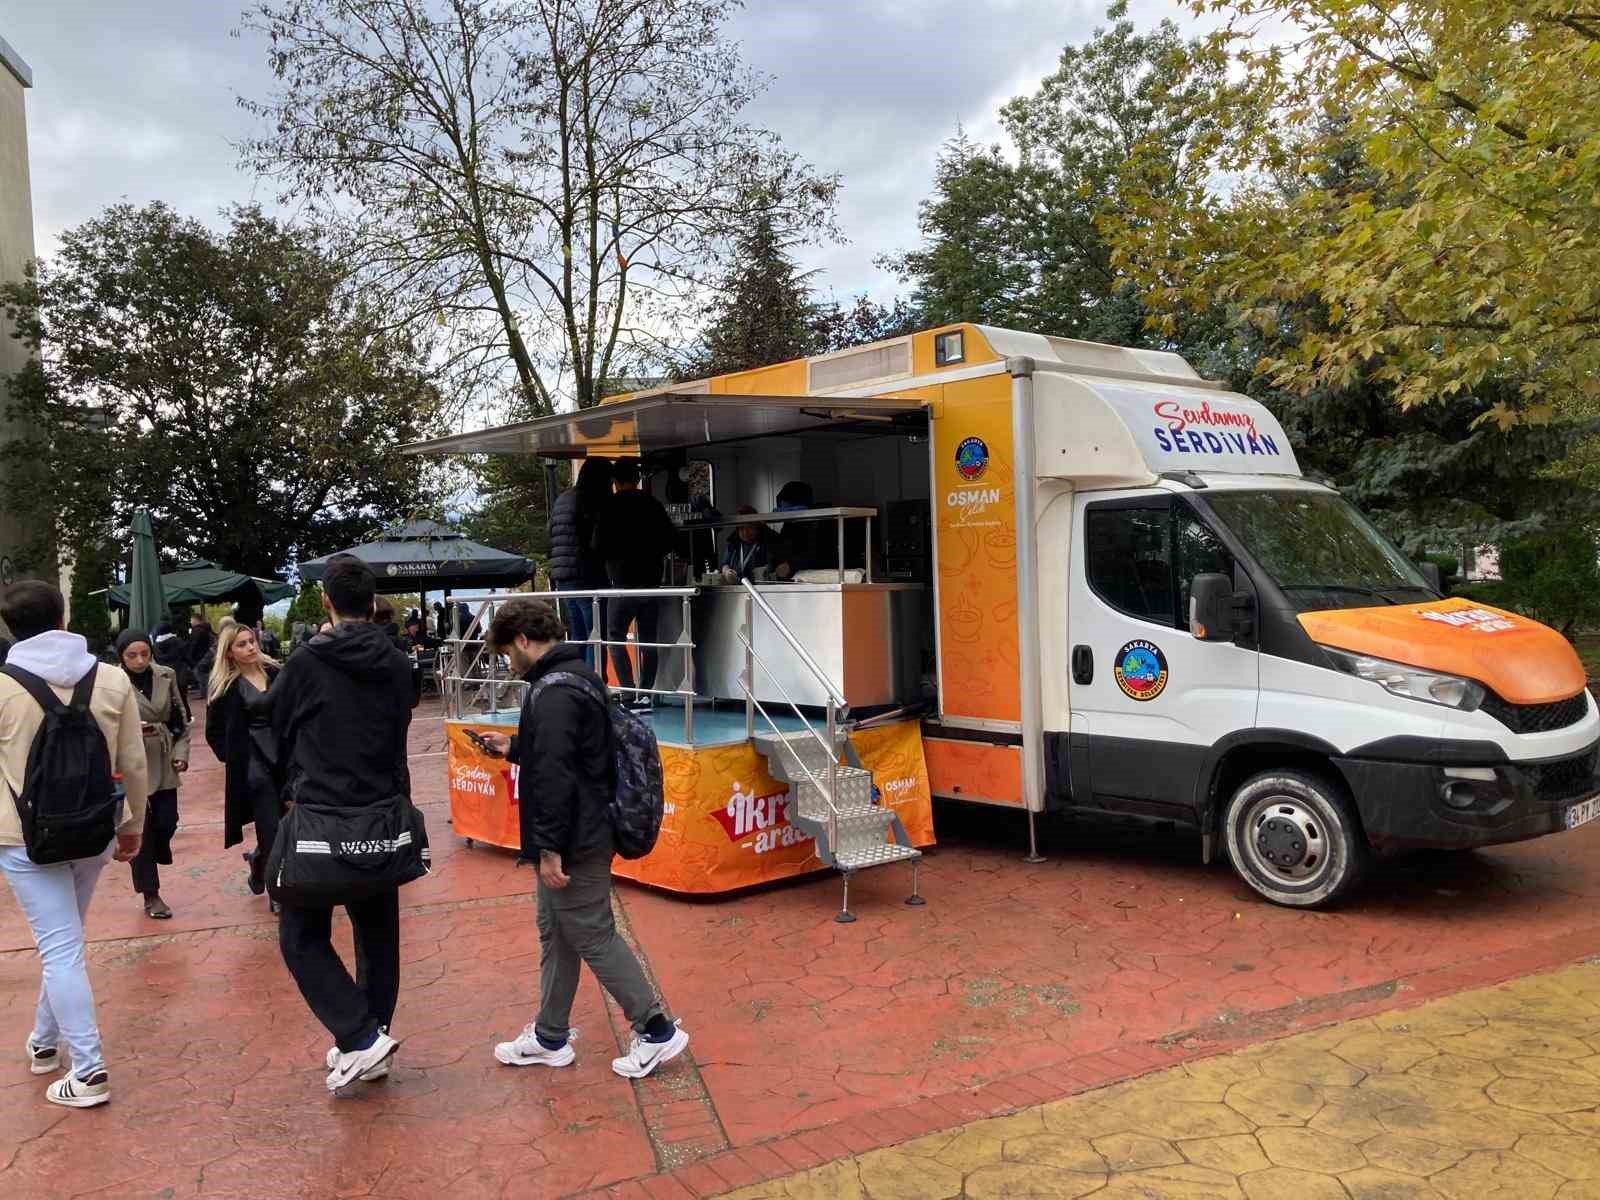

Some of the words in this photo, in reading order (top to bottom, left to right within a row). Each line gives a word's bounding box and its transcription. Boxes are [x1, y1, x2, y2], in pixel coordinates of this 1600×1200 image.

[947, 488, 1000, 507] OSMAN
[399, 562, 437, 571] SAKARYA
[1124, 641, 1158, 655] SAKARYA
[885, 777, 916, 792] OSMAN
